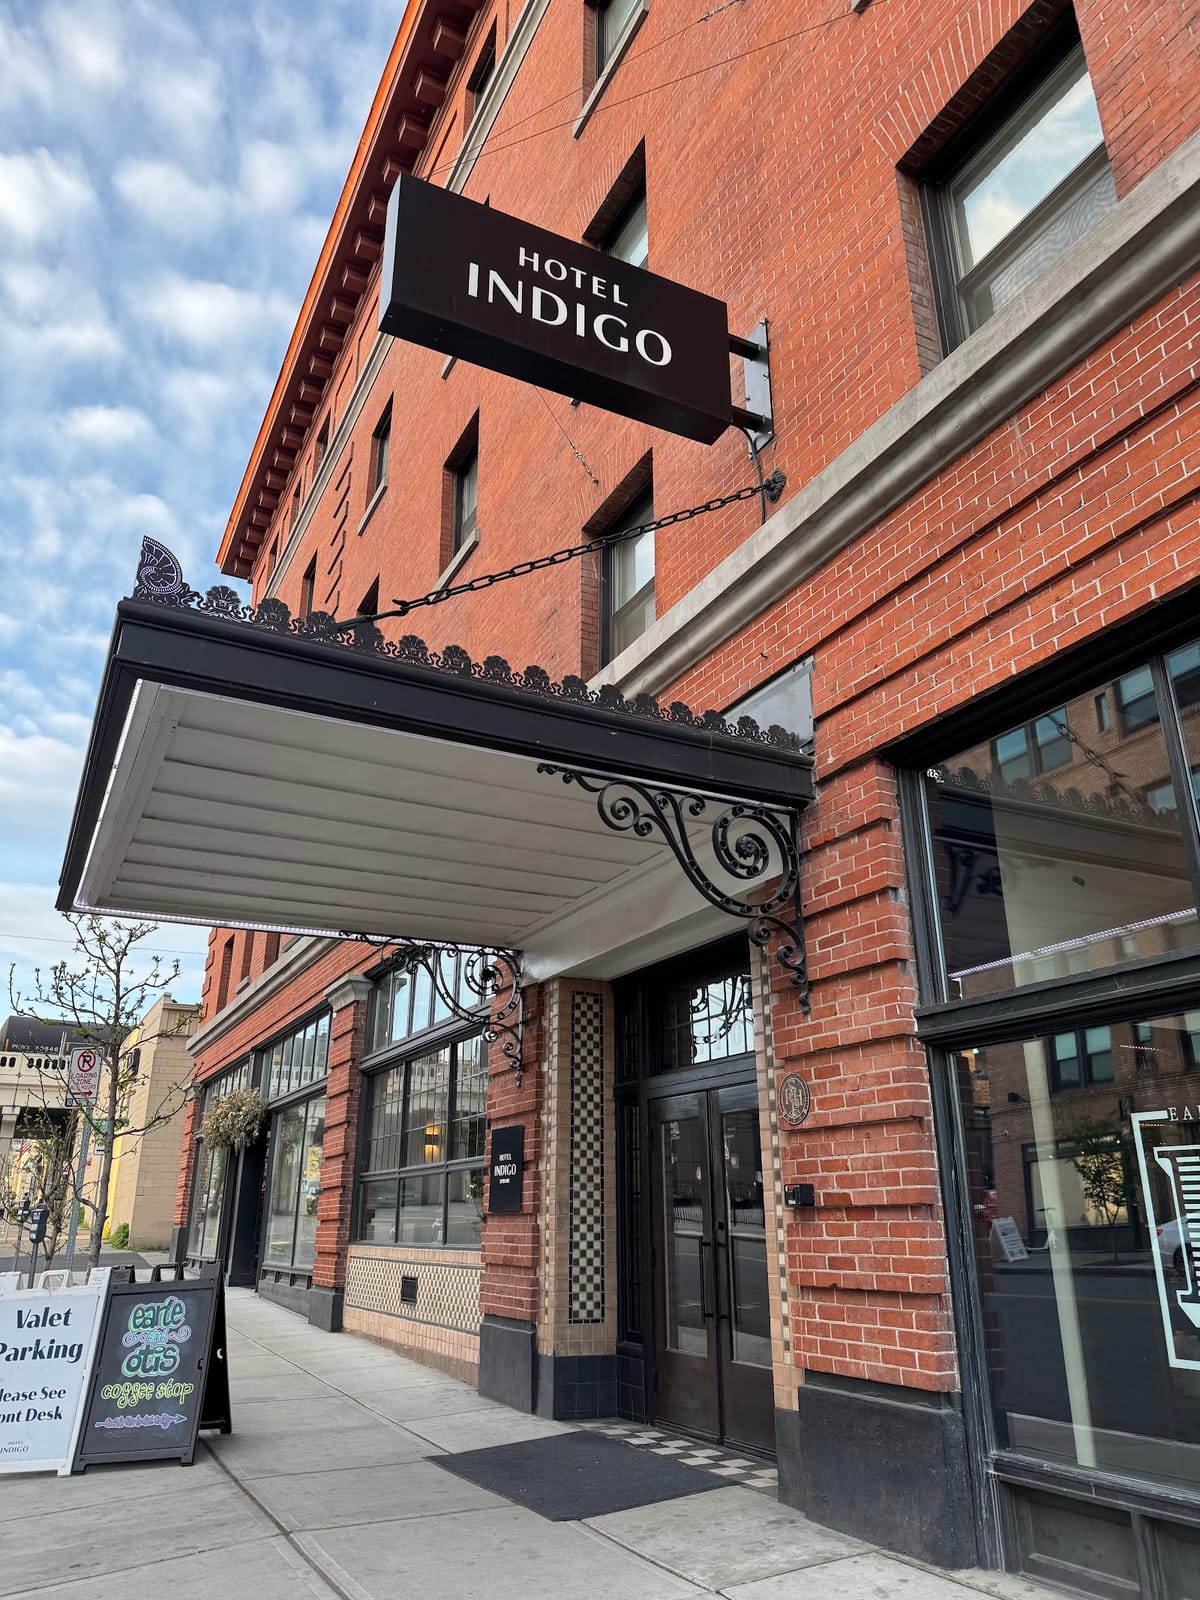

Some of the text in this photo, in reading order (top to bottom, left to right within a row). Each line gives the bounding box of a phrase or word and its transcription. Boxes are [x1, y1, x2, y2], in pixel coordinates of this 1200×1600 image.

[518, 246, 629, 307] HOTEL
[467, 262, 673, 366] INDIGO
[71, 1072, 98, 1080] LOADING
[494, 1163, 517, 1176] INDIGO
[17, 1306, 73, 1329] Valet
[122, 1344, 180, 1376] otis
[0, 1386, 67, 1402] lease See
[101, 1378, 194, 1408] coffee stop
[0, 1406, 63, 1424] ont Desk
[0, 1445, 29, 1454] INDIGO
